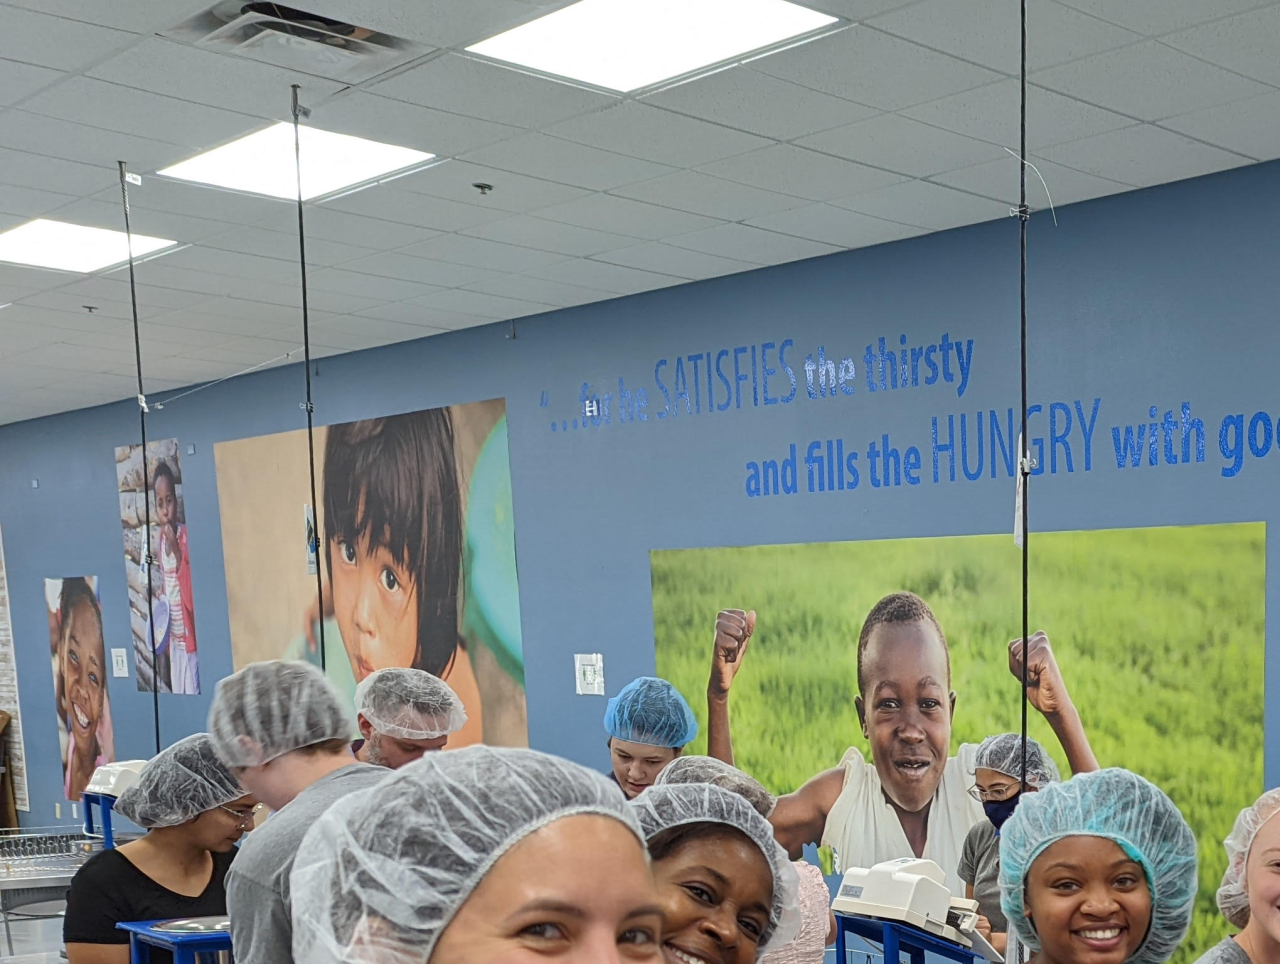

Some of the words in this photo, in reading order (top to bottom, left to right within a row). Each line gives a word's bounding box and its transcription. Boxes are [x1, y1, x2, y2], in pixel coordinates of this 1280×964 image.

[618, 377, 649, 422] he
[655, 339, 797, 419] SATISFIES
[804, 346, 854, 398] the
[864, 333, 974, 397] thirsty
[745, 444, 797, 498] and
[804, 441, 859, 492] fills
[866, 435, 921, 487] the
[931, 397, 1100, 484] HUNGRY
[1112, 402, 1205, 469] with
